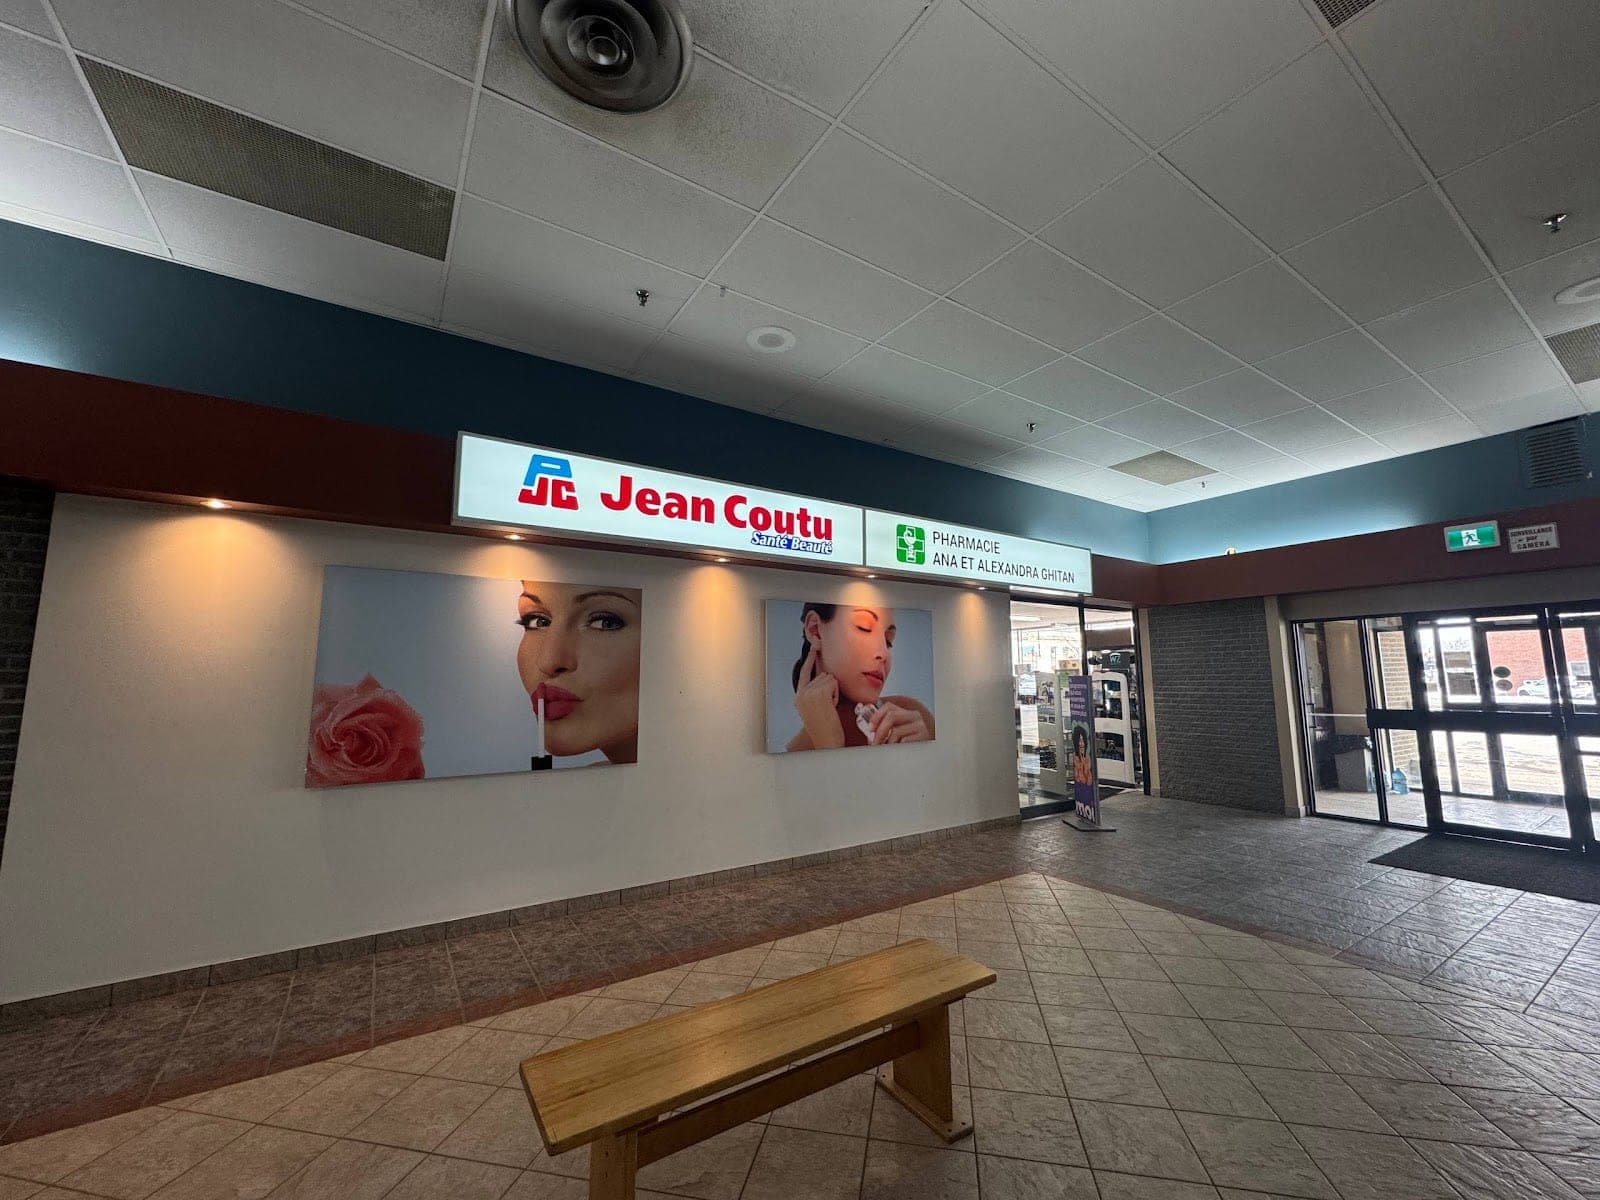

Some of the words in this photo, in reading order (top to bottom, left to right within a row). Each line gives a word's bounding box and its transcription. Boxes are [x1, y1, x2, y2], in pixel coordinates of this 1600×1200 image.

[600, 475, 715, 524] Jean
[724, 495, 832, 540] Coutu
[751, 531, 788, 548] Santé
[790, 537, 833, 555] Beauté
[933, 531, 1000, 554] PHARMACIE
[933, 552, 958, 568] ANA
[961, 556, 975, 570] ET
[977, 559, 1039, 579] ALEXANDRA
[1041, 568, 1075, 584] GHITAN
